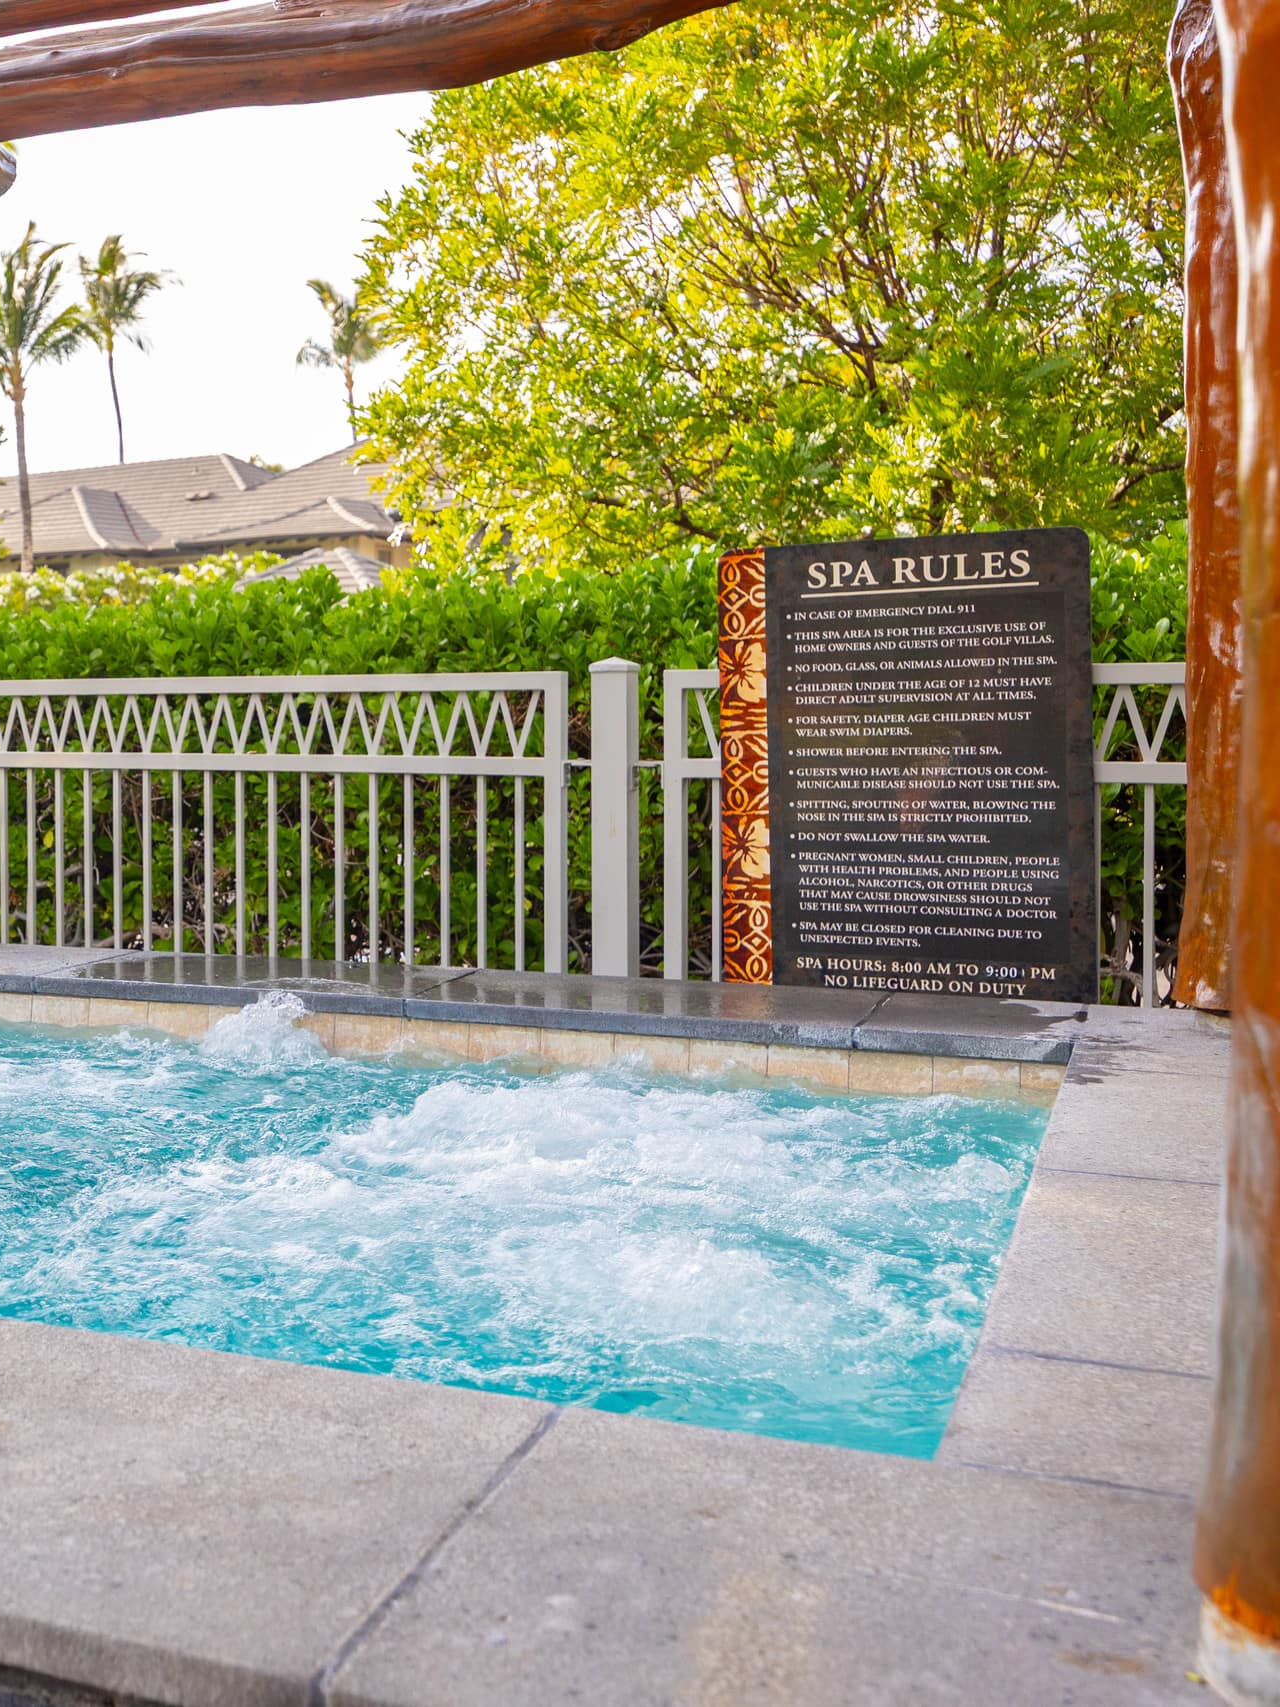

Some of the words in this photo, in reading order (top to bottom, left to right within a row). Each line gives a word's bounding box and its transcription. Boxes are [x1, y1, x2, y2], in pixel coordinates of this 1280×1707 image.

[807, 559, 879, 589] SPA
[892, 549, 1030, 584] RULES
[794, 611, 806, 621] IN
[808, 609, 836, 620] CASE
[837, 609, 853, 619] OF
[855, 606, 925, 618] EMERGENCY
[927, 604, 955, 615] DIAL
[957, 604, 975, 614] 911
[794, 630, 820, 641] THIS
[822, 630, 841, 640] SPA
[842, 628, 871, 639] AREA
[873, 628, 884, 638] IS
[886, 627, 909, 637] FOR
[911, 626, 935, 636] THE
[938, 623, 1001, 635] EXCLUSIVE
[1004, 622, 1027, 633] USE
[1029, 621, 1046, 632] OF
[794, 642, 826, 653] HOME
[827, 641, 871, 652] OWNERS
[873, 640, 896, 650] AND
[898, 638, 938, 650] GUESTS
[940, 638, 955, 648] OF
[956, 637, 980, 648] THE
[982, 636, 1012, 647] GOLF
[1013, 634, 1054, 646] VILLAS.
[794, 663, 810, 673] NO
[812, 662, 843, 673] FOOD,
[845, 660, 878, 672] GLASS,
[879, 660, 895, 670] OR
[896, 658, 942, 670] ANIMALS
[943, 657, 995, 668] ALLOWED
[997, 656, 1010, 666] IN
[1011, 655, 1034, 666] THE
[1036, 655, 1057, 665] SPA.
[794, 681, 853, 693] CHILDREN
[855, 680, 895, 691] UNDER
[897, 680, 921, 690] THE
[923, 679, 947, 689] AGE
[948, 678, 965, 689] OF
[968, 678, 980, 688] 12
[983, 677, 1017, 688] MUST
[1020, 676, 1052, 687] HAVE
[795, 694, 837, 705] DIRECT
[838, 693, 876, 704] ADULT
[878, 692, 953, 703] SUPERVISION
[955, 692, 970, 702] AT
[972, 691, 995, 701] ALL
[996, 690, 1036, 701] TIMES.
[795, 715, 818, 725] FOR
[819, 714, 861, 726] SAFETY,
[863, 714, 905, 724] DIAPER
[907, 713, 930, 723] AGE
[932, 712, 994, 723] CHILDREN
[997, 711, 1032, 721] MUST
[795, 727, 827, 737] WEAR
[829, 727, 860, 737] SWIM
[862, 726, 912, 736] DIAPERS.
[796, 747, 843, 757] SHOWER
[845, 746, 889, 756] BEFORE
[891, 746, 950, 756] ENTERING
[951, 746, 977, 756] THE
[979, 746, 1002, 755] SPA.
[796, 767, 837, 777] GUESTS
[838, 767, 868, 777] WHO
[870, 767, 900, 776] HAVE
[902, 767, 918, 776] AN
[921, 766, 992, 776] INFECTIOUS
[994, 766, 1012, 776] OR
[1014, 766, 1048, 776] COM-
[796, 780, 860, 789] MUNICABLE
[862, 780, 906, 789] DISEASE
[908, 780, 956, 789] SHOULD
[958, 780, 984, 789] NOT
[986, 780, 1008, 789] USE
[1009, 780, 1035, 789] THE
[1036, 780, 1060, 789] SPA.
[796, 799, 850, 810] SPITTING,
[851, 799, 909, 809] SPOUTING
[911, 800, 927, 809] OF
[928, 800, 970, 810] WATER,
[972, 800, 1028, 810] BLOWING
[1030, 800, 1056, 810] THE
[797, 812, 826, 822] NOSE
[828, 812, 840, 822] IN
[841, 812, 865, 822] THE
[866, 812, 885, 822] SPA
[888, 812, 898, 822] IS
[900, 813, 953, 822] STRICTLY
[955, 813, 1032, 823] PROHIBITED.
[798, 832, 815, 841] DO
[817, 832, 842, 842] NOT
[843, 832, 899, 842] SWALLOW
[899, 833, 924, 842] THE
[926, 833, 946, 843] SPA
[948, 833, 990, 843] WATER.
[798, 852, 856, 862] PREGNANT
[858, 853, 905, 864] WOMEN,
[907, 854, 944, 864] SMALL
[946, 855, 1012, 866] CHILDREN,
[1014, 856, 1060, 866] PEOPLE
[798, 864, 829, 874] WITH
[831, 865, 875, 875] HEALTH
[878, 866, 942, 878] PROBLEMS,
[944, 867, 970, 877] AND
[972, 868, 1018, 878] PEOPLE
[1021, 869, 1059, 879] USING
[798, 876, 855, 888] ALCOHOL,
[857, 878, 924, 890] NARCOTICS,
[926, 880, 944, 890] OR
[946, 880, 988, 891] OTHER
[991, 882, 1033, 892] DRUGS
[798, 889, 828, 899] THAT
[830, 890, 854, 900] MAY
[855, 890, 891, 901] CAUSE
[893, 892, 967, 903] DROWSINESS
[969, 894, 1021, 905] SHOULD
[1024, 895, 1051, 906] NOT
[799, 901, 819, 911] USE
[819, 902, 842, 912] THE
[843, 903, 862, 913] SPA
[863, 903, 918, 915] WITHOUT
[919, 905, 992, 917] CONSULTING
[994, 908, 1002, 918] A
[1006, 908, 1057, 920] DOCTOR
[799, 921, 818, 931] SPA
[819, 922, 843, 932] MAY
[845, 923, 859, 933] BE
[861, 923, 906, 934] CLOSED
[908, 925, 932, 935] FOR
[934, 926, 994, 938] CLEANING
[997, 928, 1023, 939] DUE
[1024, 930, 1042, 940] TO
[800, 933, 873, 945] UNEXPECTED
[875, 936, 920, 947] EVENTS.
[796, 957, 822, 970] SPA
[827, 958, 886, 973] HOURS:
[891, 961, 922, 974] 8:00
[926, 962, 951, 975] AM
[955, 964, 979, 976] TO
[985, 965, 1018, 978] 9:00
[1030, 967, 1055, 980] PM
[824, 975, 848, 988] NO
[853, 976, 943, 992] LIFEGUARD
[948, 980, 973, 993] ON
[979, 982, 1026, 996] DUTY
